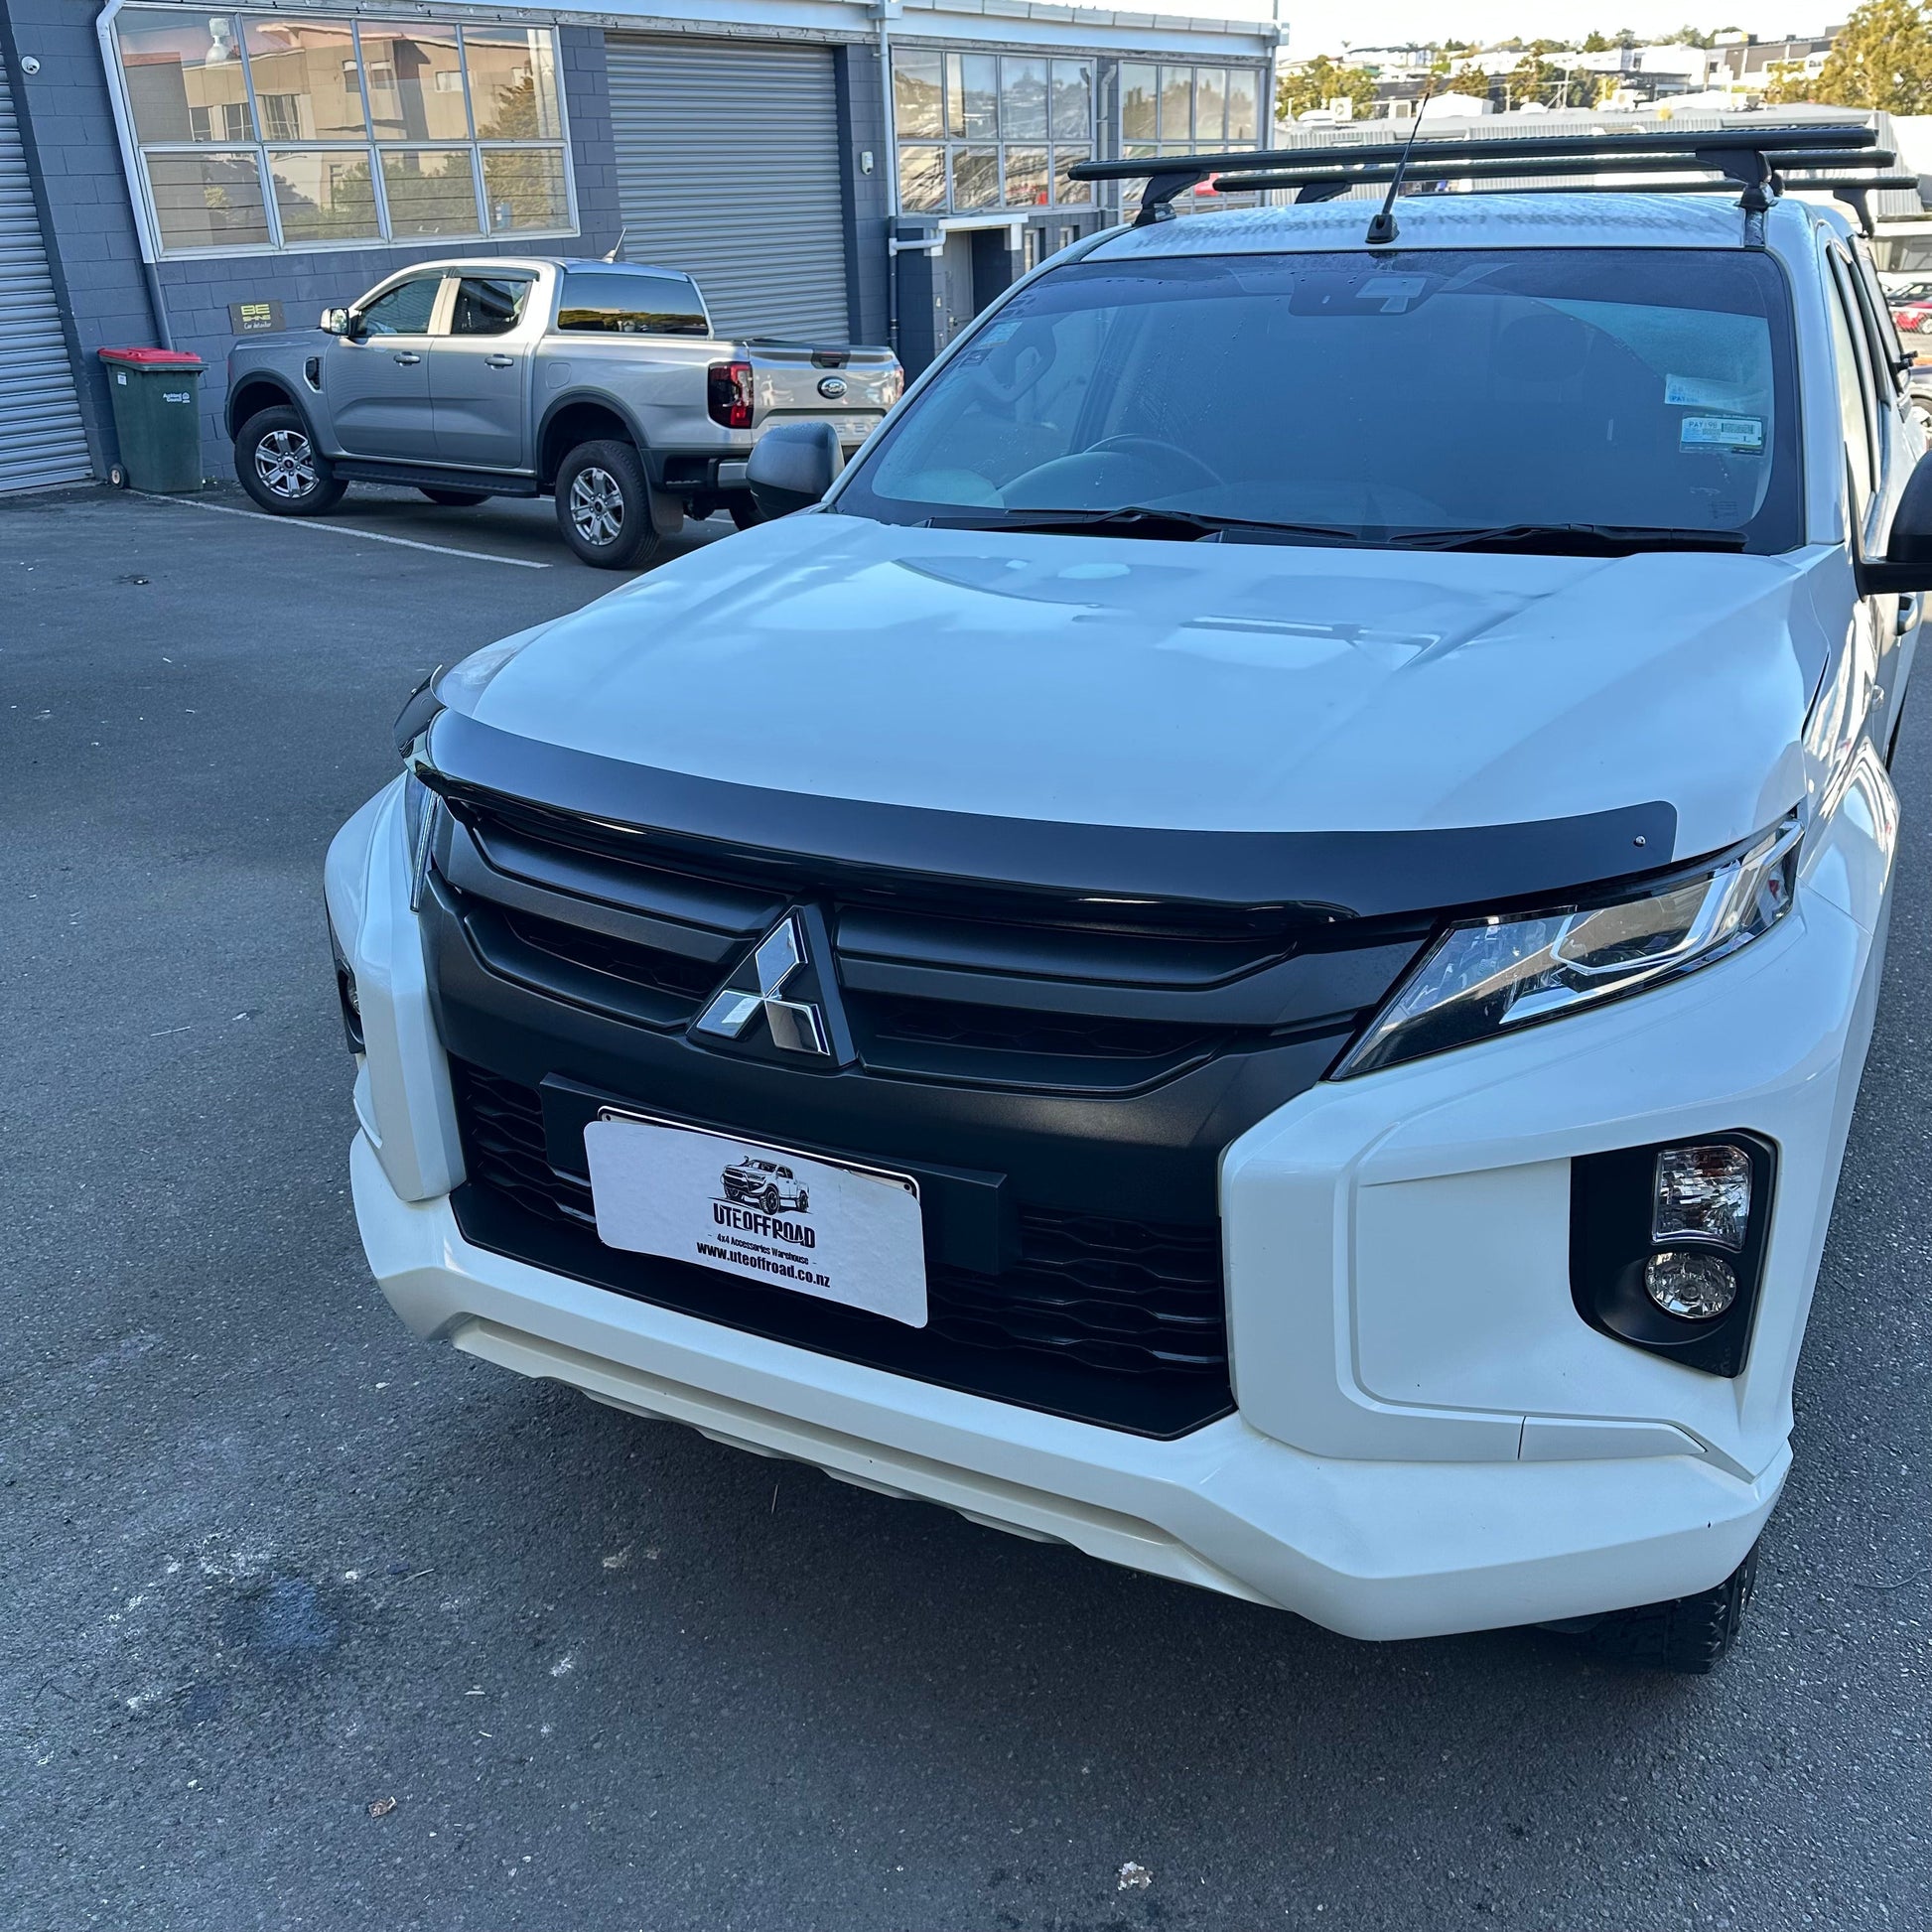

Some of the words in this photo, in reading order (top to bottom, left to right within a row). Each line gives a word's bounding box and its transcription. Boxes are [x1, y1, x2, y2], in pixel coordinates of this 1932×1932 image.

[241, 304, 270, 315] BE
[697, 1242, 831, 1288] www.uteoffroad.co.nz
[717, 1233, 730, 1244] 4x4
[730, 1237, 771, 1255] Accessories
[771, 1247, 809, 1265] Warehouse
